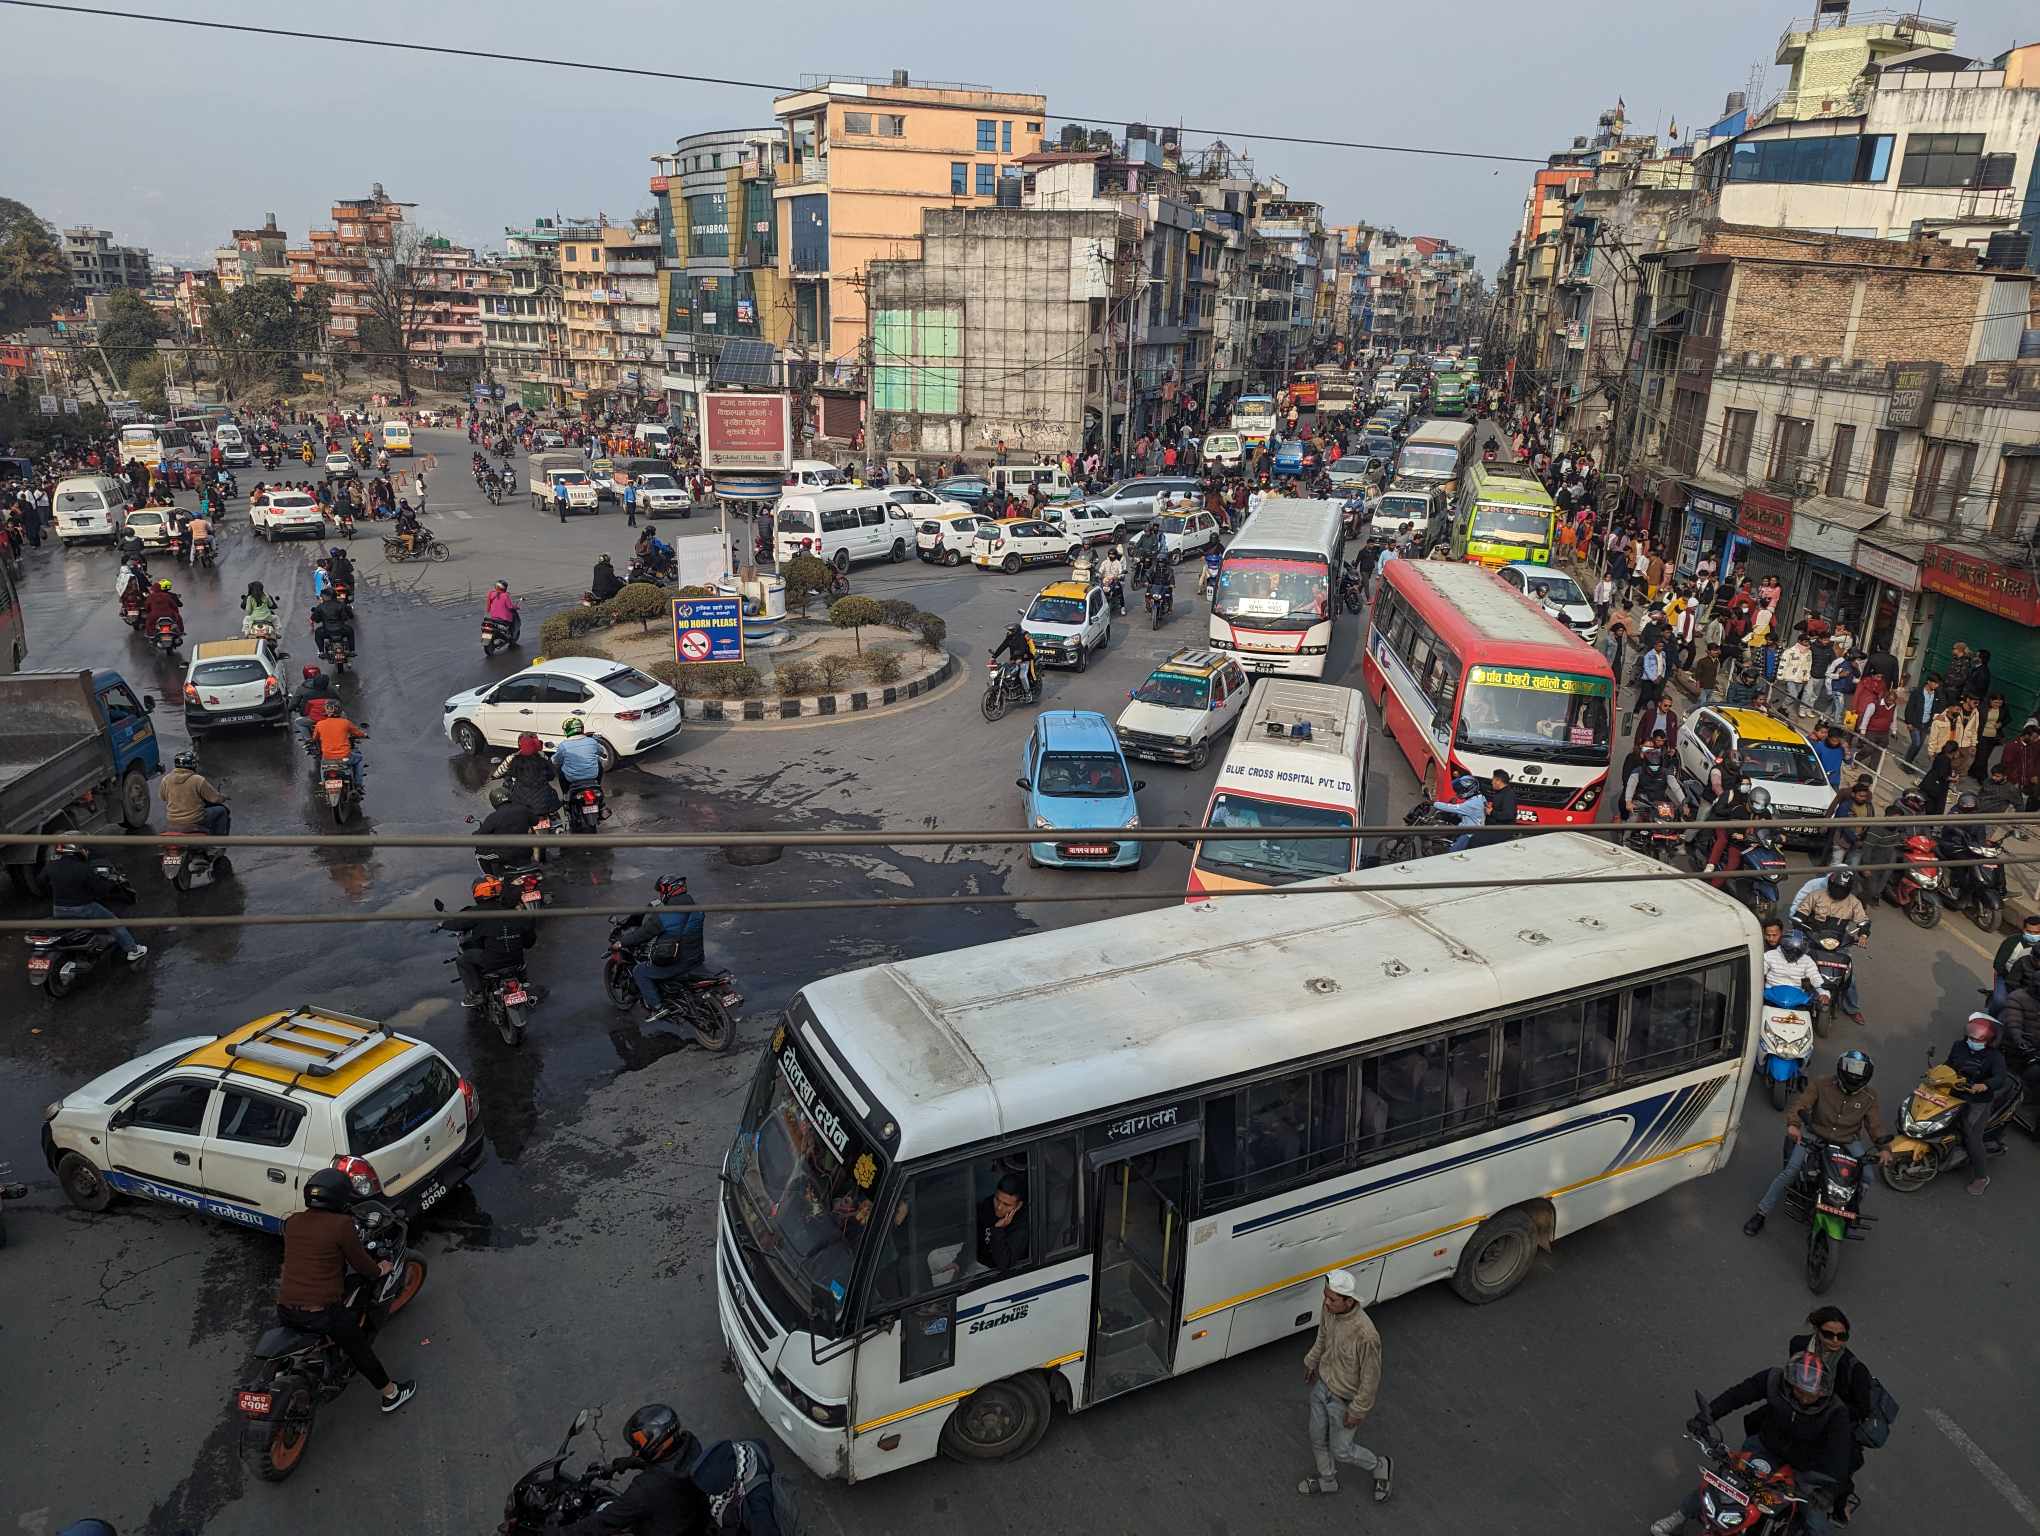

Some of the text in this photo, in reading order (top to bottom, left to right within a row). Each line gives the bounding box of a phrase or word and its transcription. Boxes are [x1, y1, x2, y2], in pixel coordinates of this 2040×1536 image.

[679, 618, 738, 629] NO HORN PLEASE
[1225, 764, 1353, 793] BLUE CROSS HOSPITAL PVT. LTD.
[783, 1045, 850, 1152] दोलखा दर्शन
[1012, 1304, 1030, 1313] TATA
[968, 1309, 1030, 1335] Starbus
